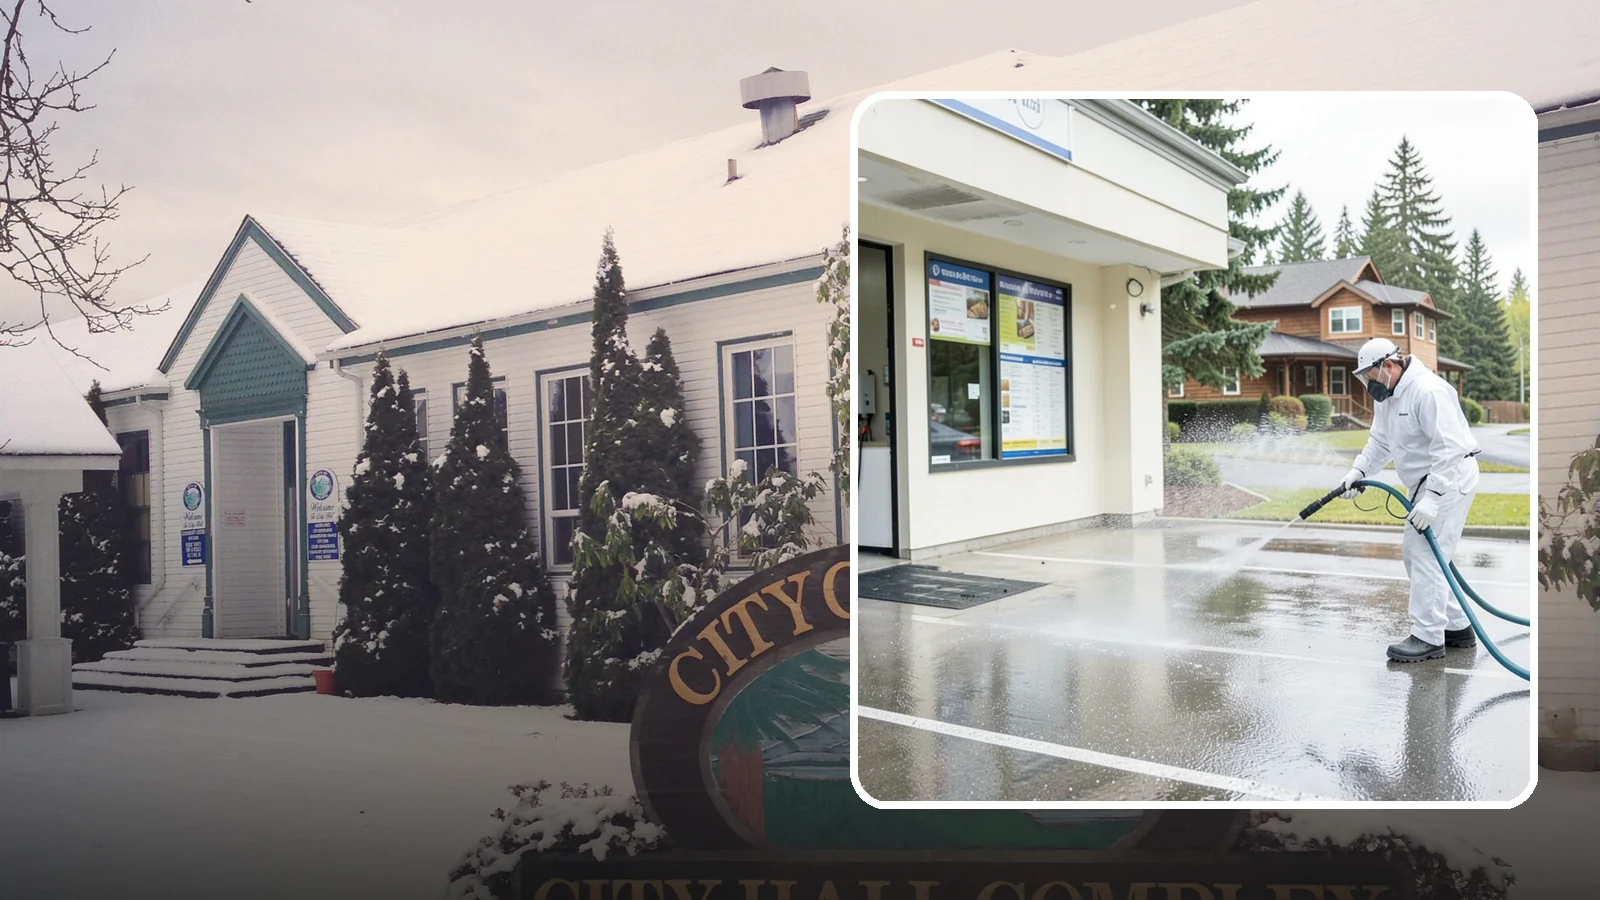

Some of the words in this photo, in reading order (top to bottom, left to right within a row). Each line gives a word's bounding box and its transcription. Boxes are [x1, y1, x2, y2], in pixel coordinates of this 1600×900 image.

[310, 504, 334, 512] Welcome
[184, 512, 203, 520] Welcome
[668, 570, 814, 704] CITY
